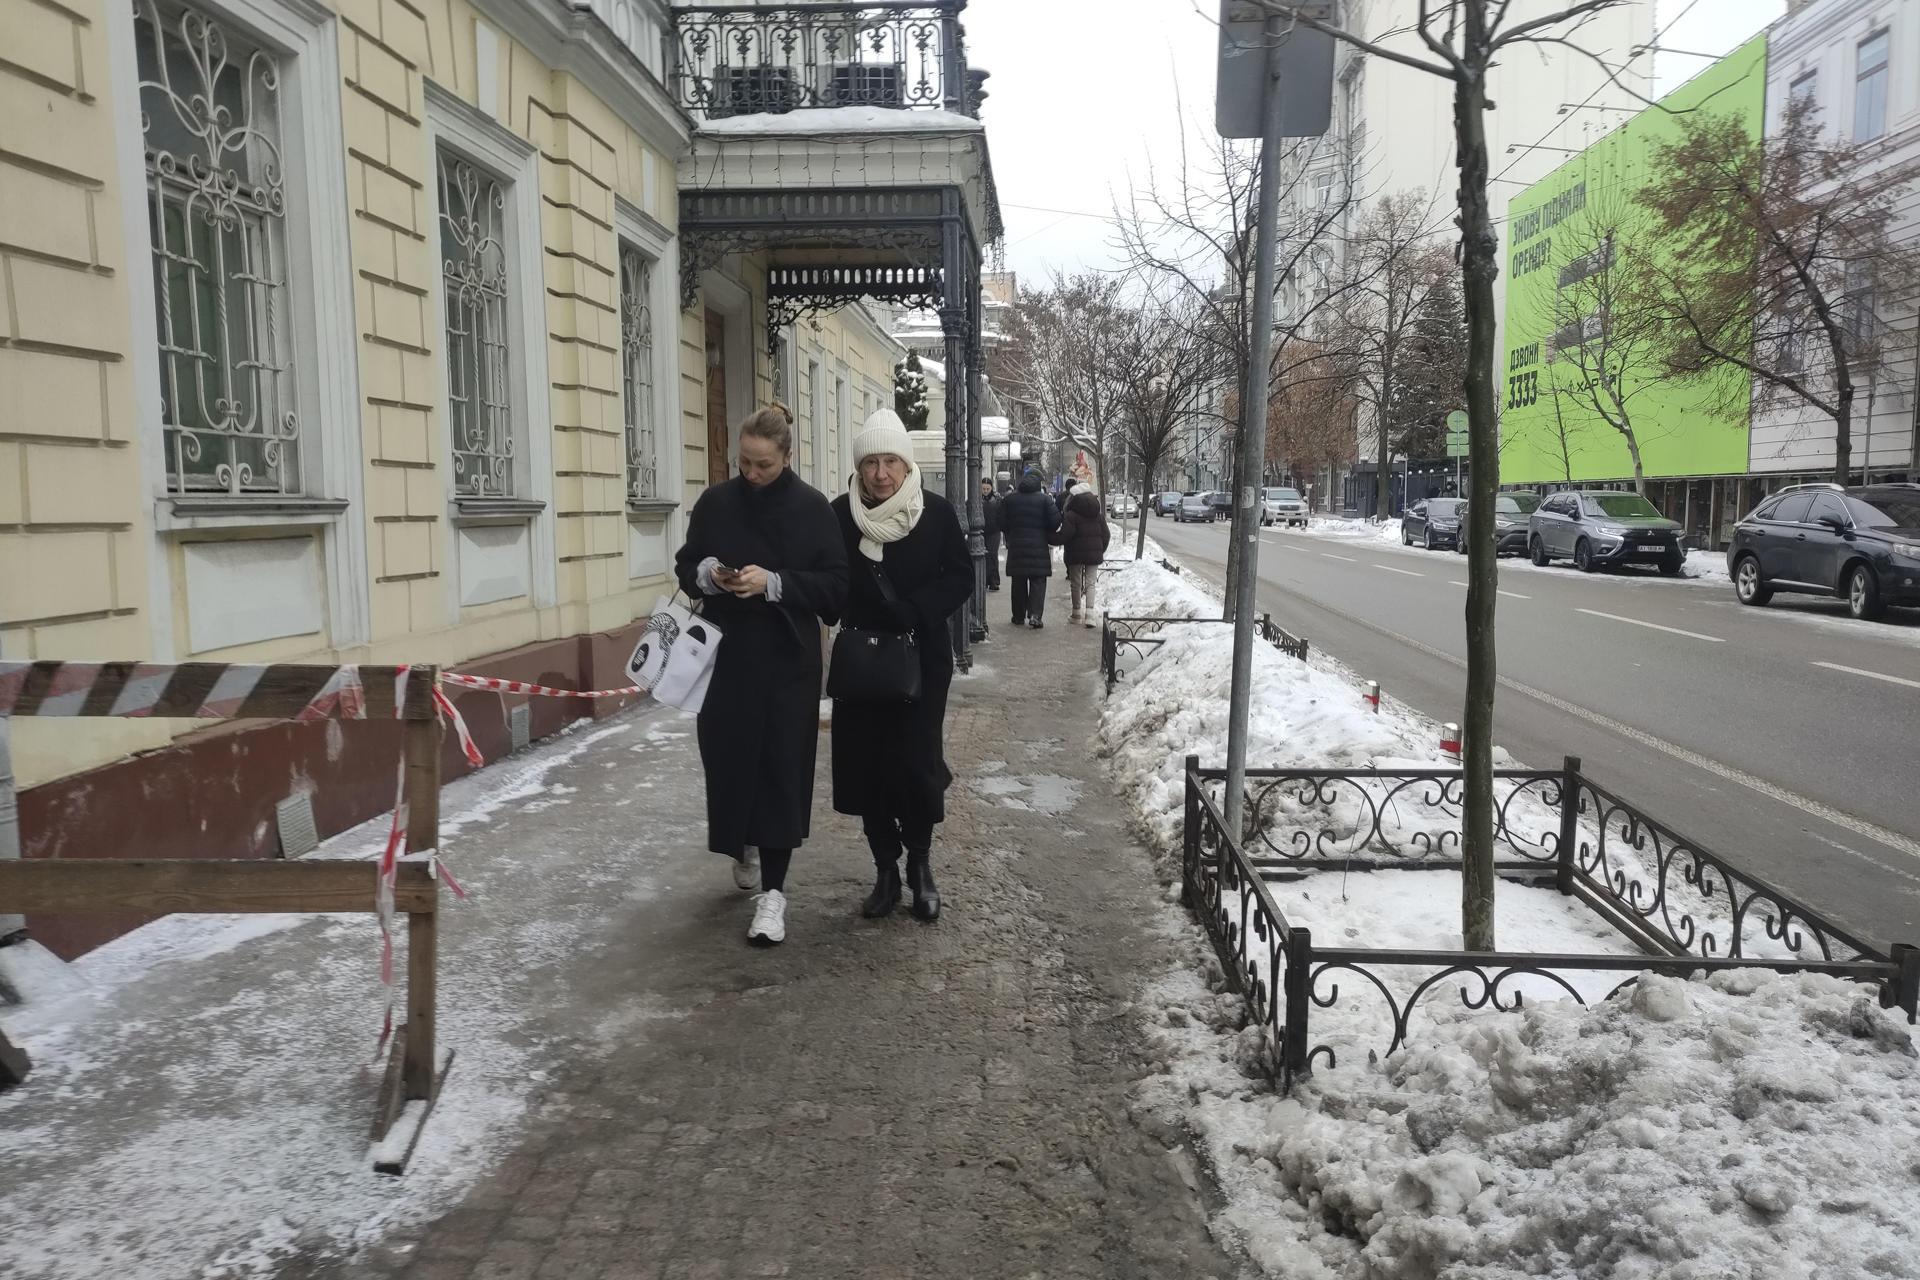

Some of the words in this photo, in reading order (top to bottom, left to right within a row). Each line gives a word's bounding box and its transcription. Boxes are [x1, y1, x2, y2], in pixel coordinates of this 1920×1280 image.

[1513, 207, 1540, 246] ЗНОВУ
[1513, 237, 1551, 279] ОРЕНДУ?
[1510, 342, 1539, 372] ДЗВОНИ
[1508, 370, 1538, 409] 3333
